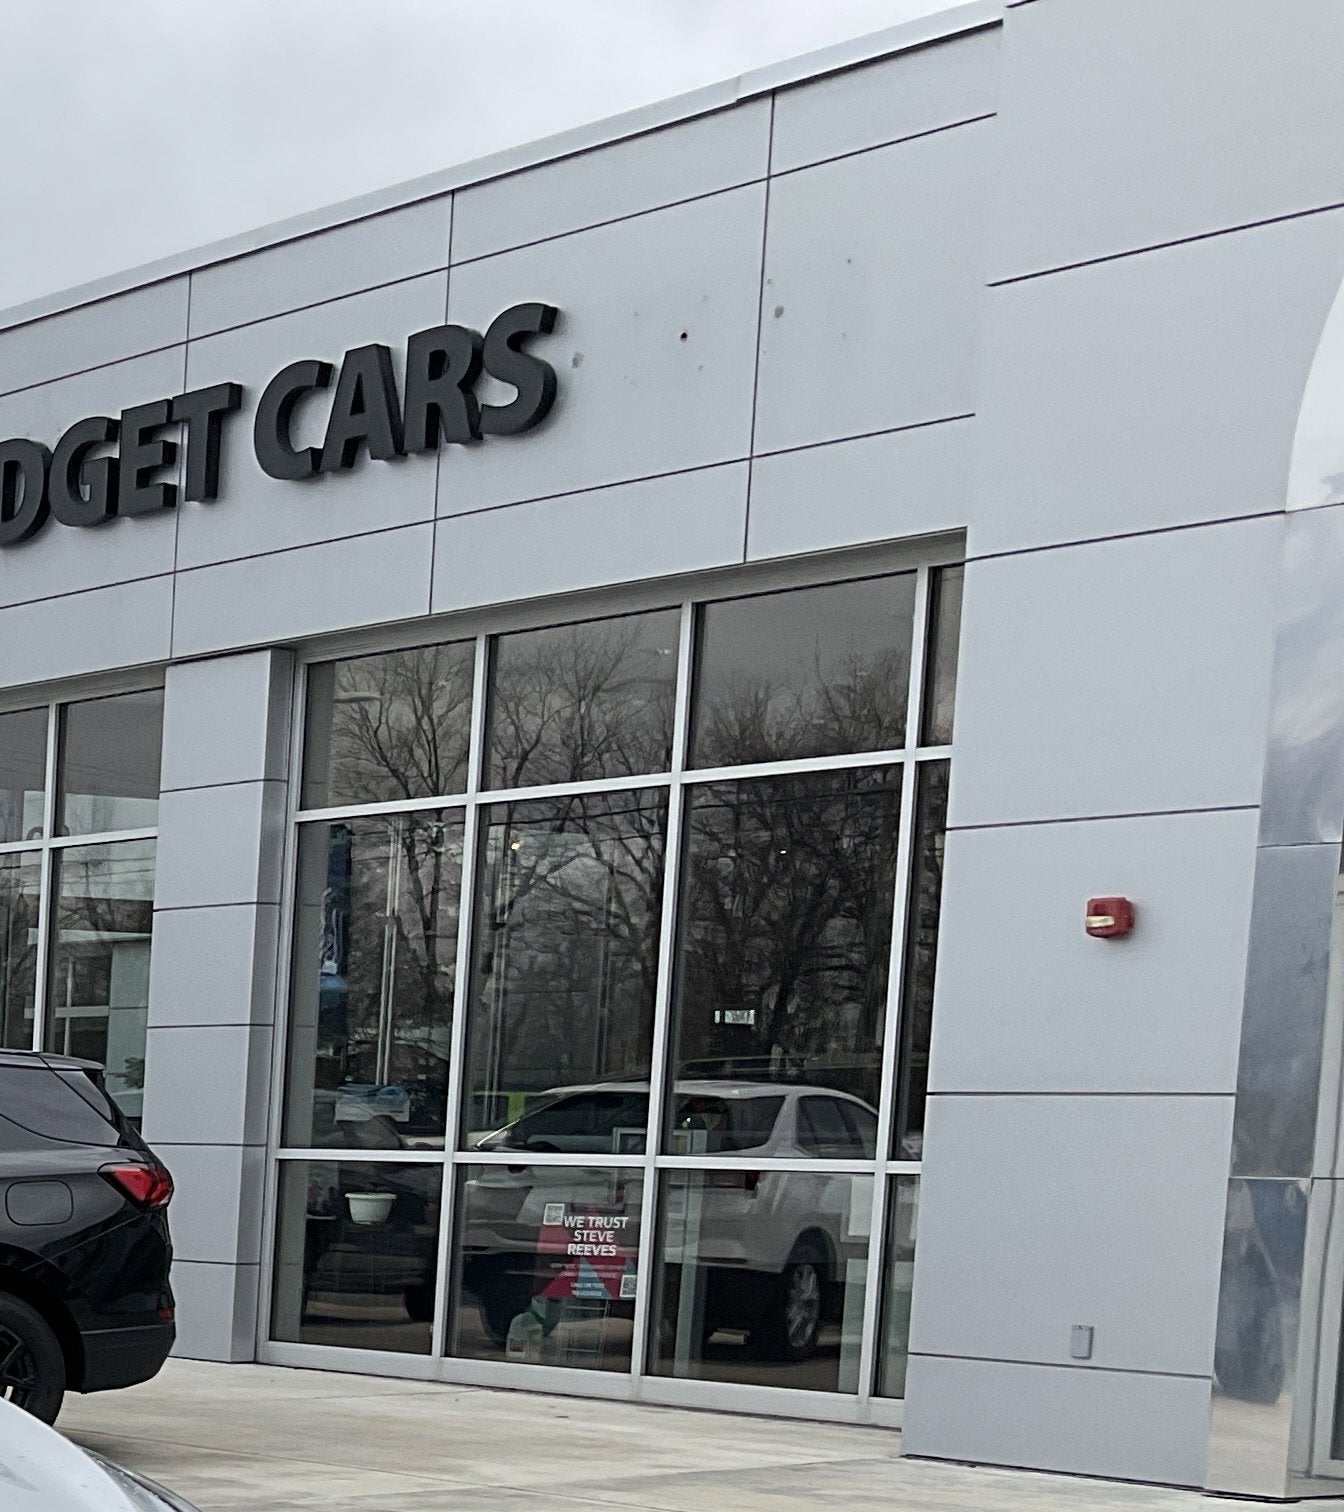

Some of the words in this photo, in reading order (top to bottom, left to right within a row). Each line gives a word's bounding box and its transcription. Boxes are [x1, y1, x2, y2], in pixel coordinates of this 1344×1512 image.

[254, 302, 558, 480] CARS
[564, 1215, 585, 1228] WE
[588, 1216, 629, 1229] TRUST
[573, 1230, 615, 1242] STEVE
[567, 1243, 617, 1256] REEVES
